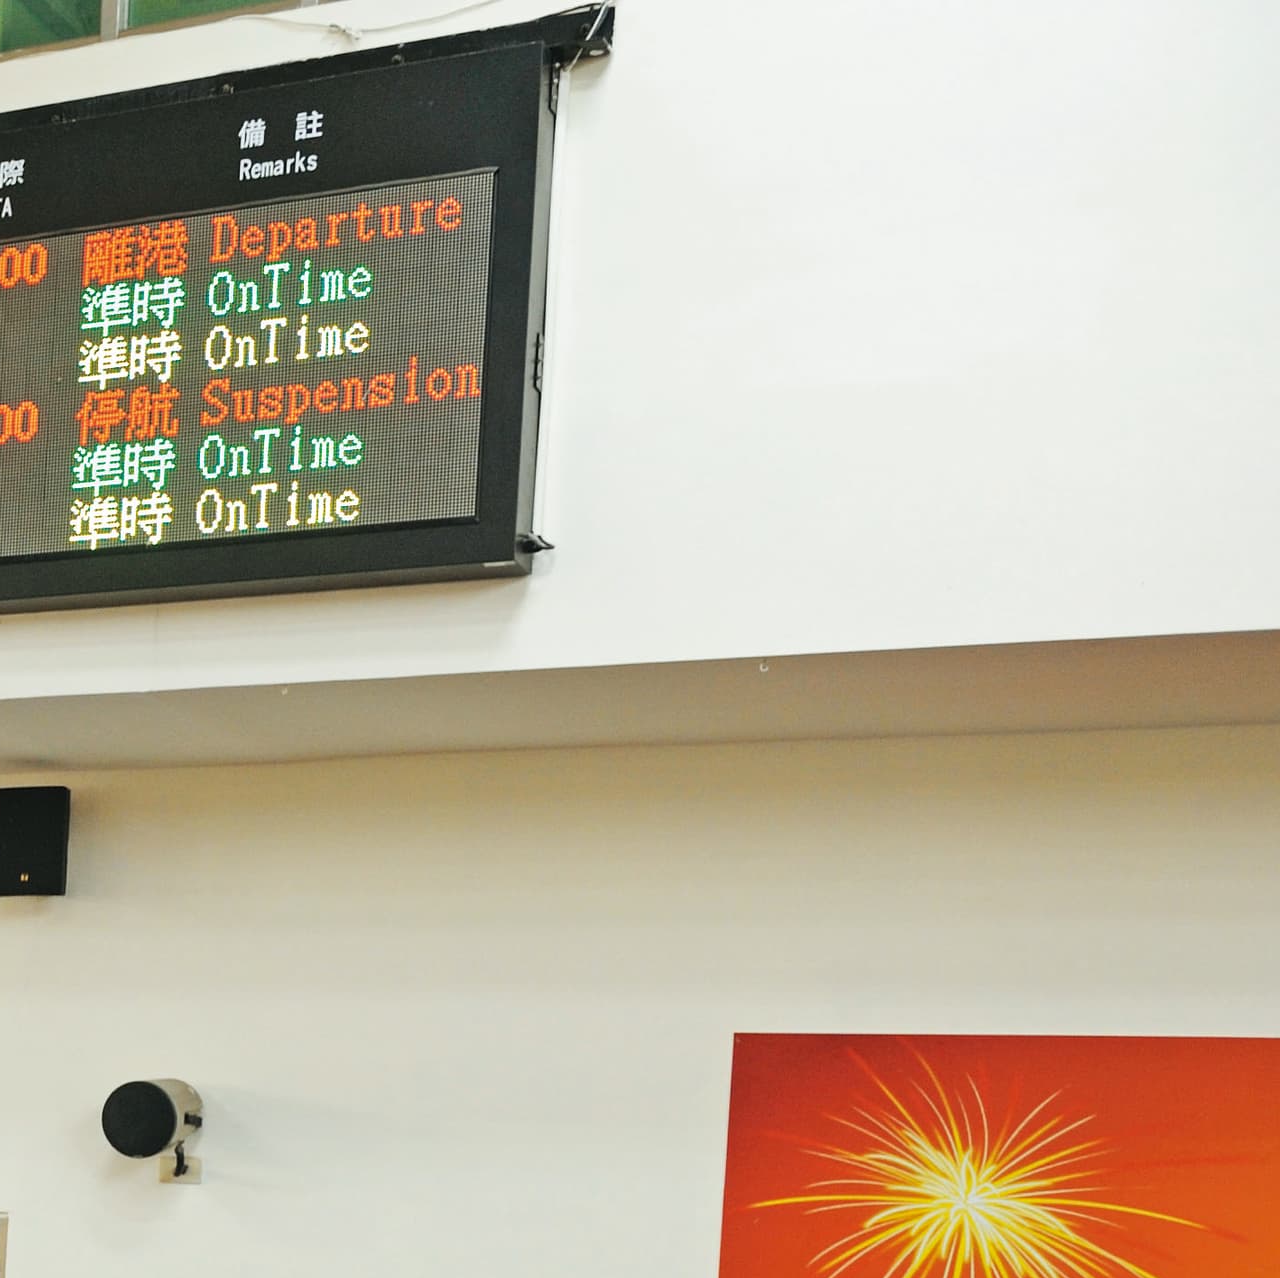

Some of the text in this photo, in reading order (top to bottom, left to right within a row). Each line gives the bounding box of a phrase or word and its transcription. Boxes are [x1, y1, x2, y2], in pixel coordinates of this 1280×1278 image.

[238, 110, 324, 150] 備註
[239, 151, 318, 181] Remarks
[81, 220, 188, 287] 離港
[209, 195, 462, 263] Departure
[80, 276, 185, 336] 準時
[207, 259, 373, 317] OnTime
[78, 329, 182, 390] 準時
[205, 316, 371, 371] OnTime
[74, 382, 180, 447] 停航
[200, 355, 481, 427] Suspension
[72, 437, 175, 496] 準時
[198, 425, 363, 480] OnTime
[69, 488, 172, 550] 準時
[195, 480, 360, 536] OnTime
